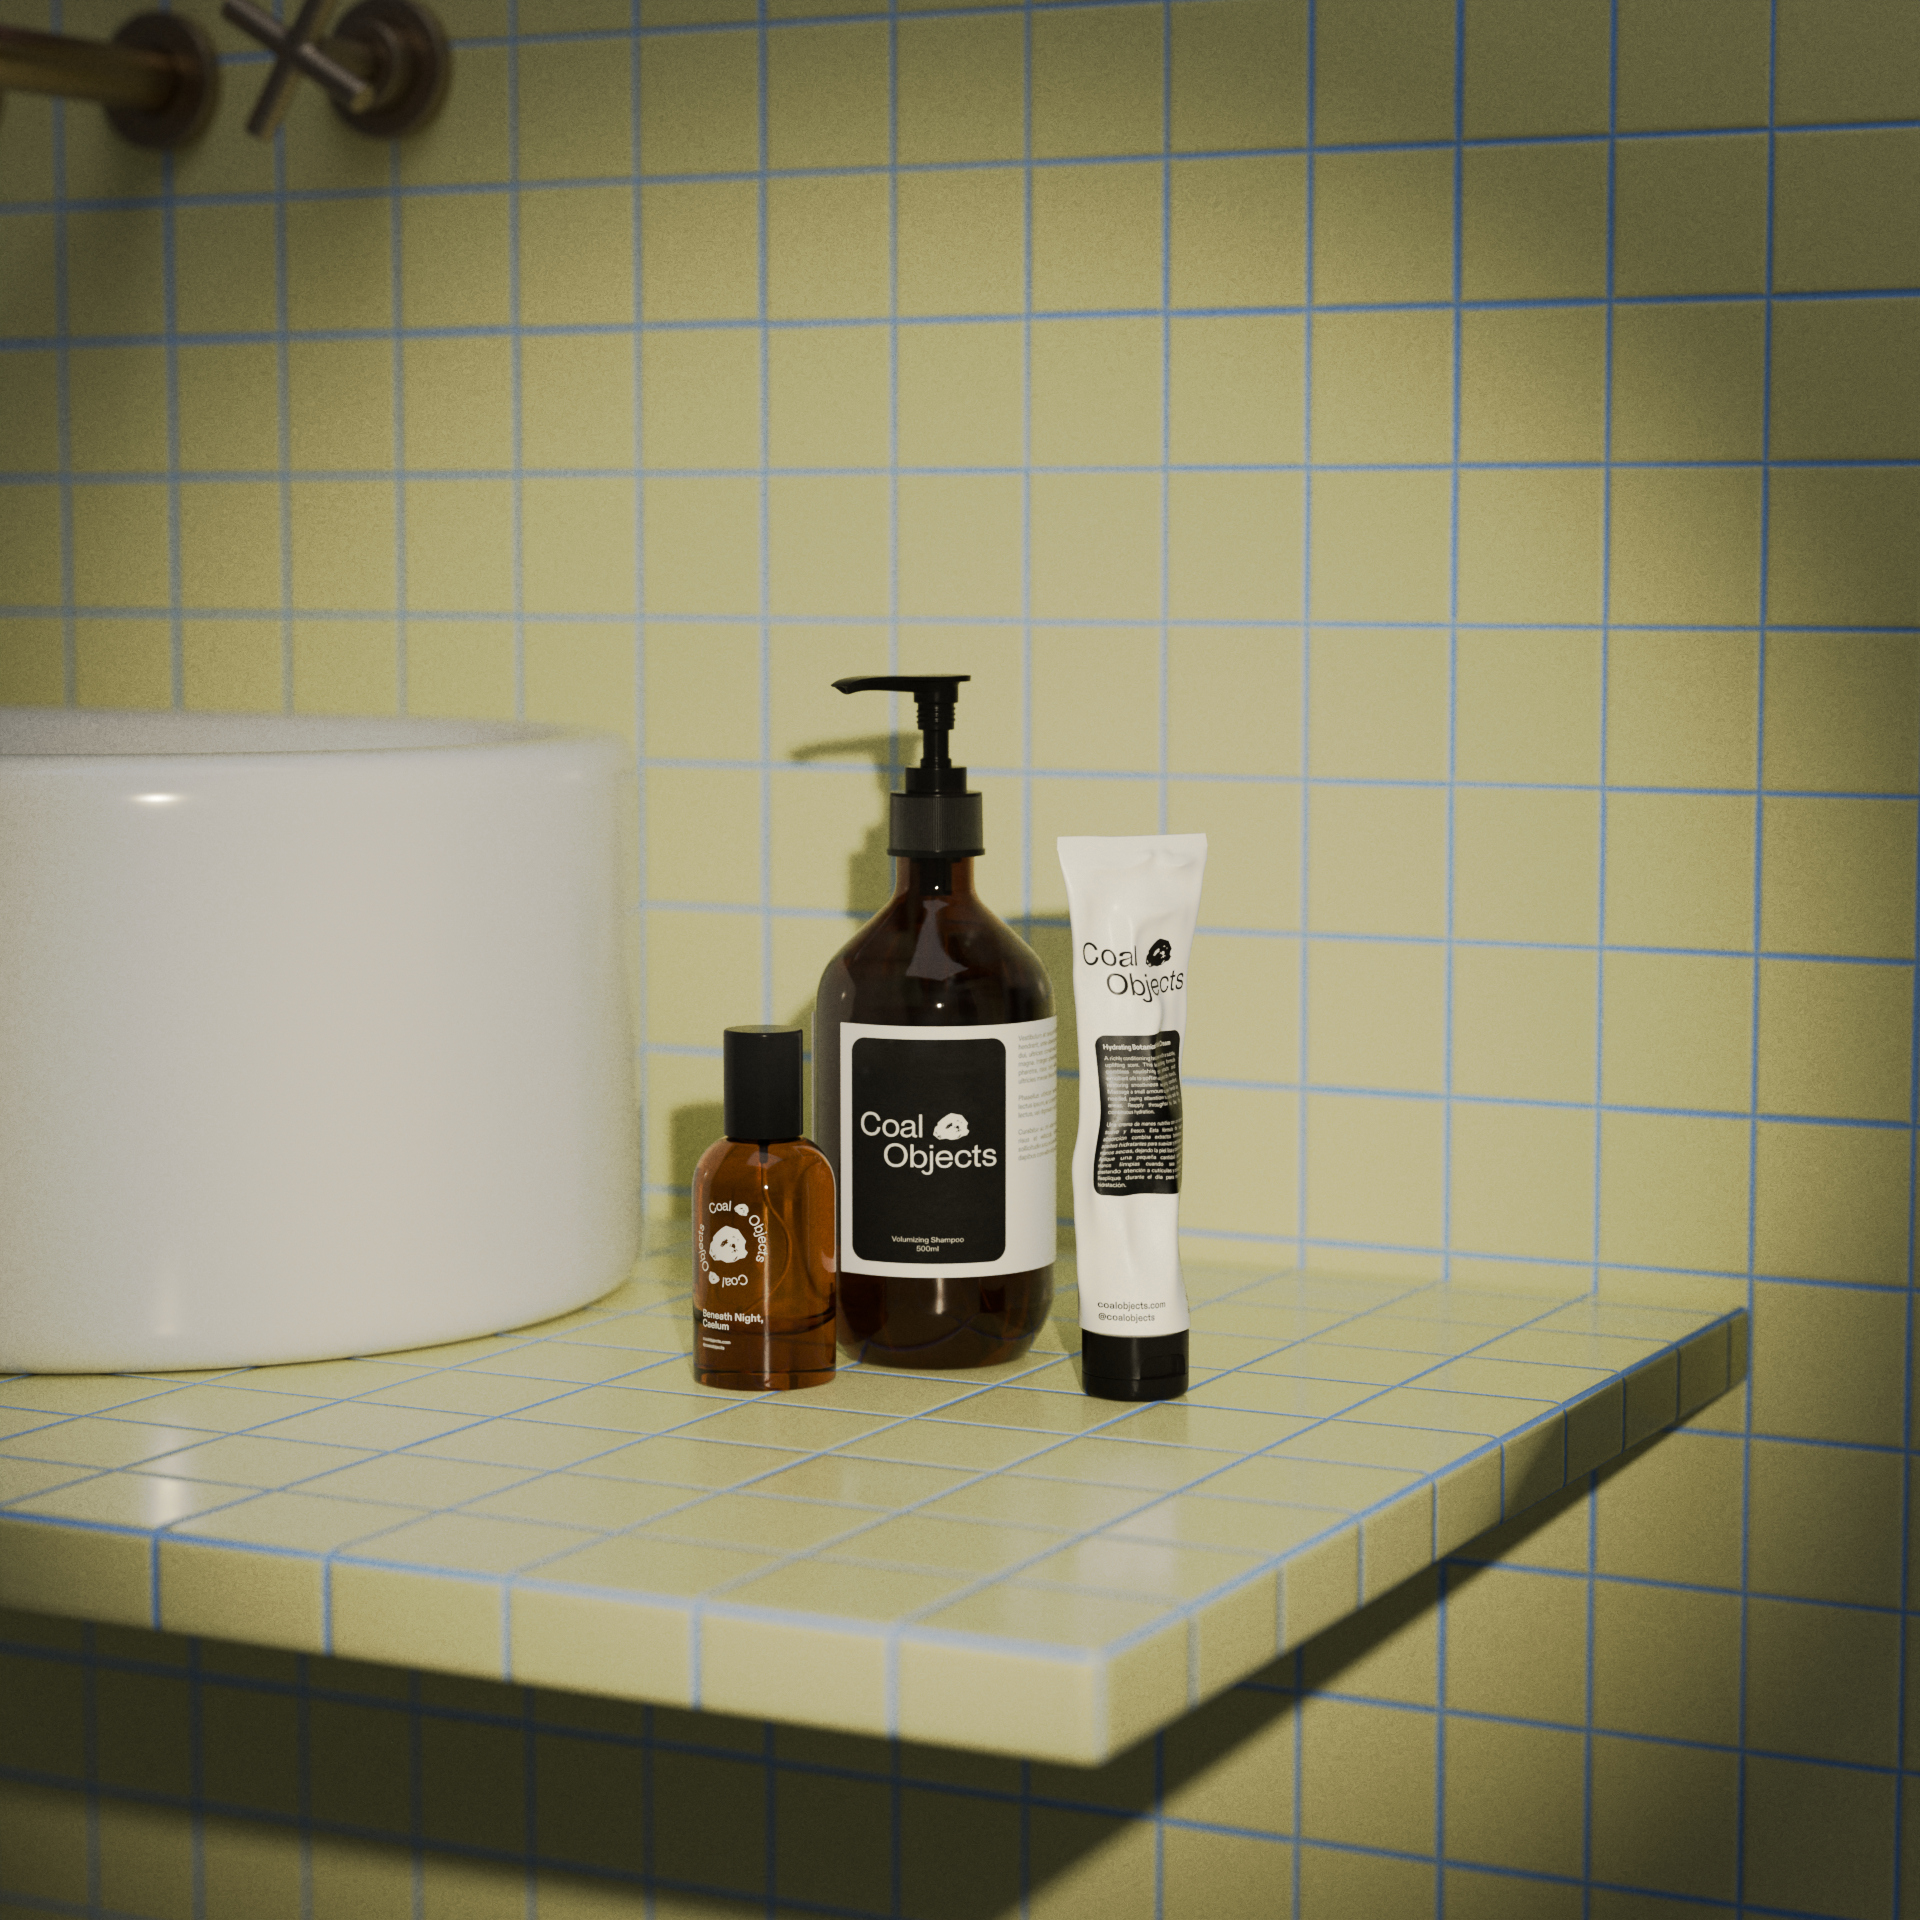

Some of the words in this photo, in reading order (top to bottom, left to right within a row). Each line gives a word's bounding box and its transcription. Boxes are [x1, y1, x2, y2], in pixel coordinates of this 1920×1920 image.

[1083, 942, 1137, 967] Coal
[1107, 970, 1184, 1003] Objects
[1103, 1044, 1131, 1052] Hydrating
[860, 1111, 923, 1138] Coal
[883, 1142, 997, 1175] Objects
[709, 1200, 732, 1214] Coal
[748, 1214, 768, 1263] Objects
[891, 1235, 929, 1244] Volumizing
[930, 1236, 965, 1244] Shampoo
[698, 1223, 709, 1272] Objects
[722, 1274, 748, 1288] Coal
[702, 1308, 733, 1321] Beneath
[734, 1312, 764, 1325] Night,
[1097, 1301, 1166, 1312] coalobjects.com
[1098, 1312, 1156, 1323] @coalobjects
